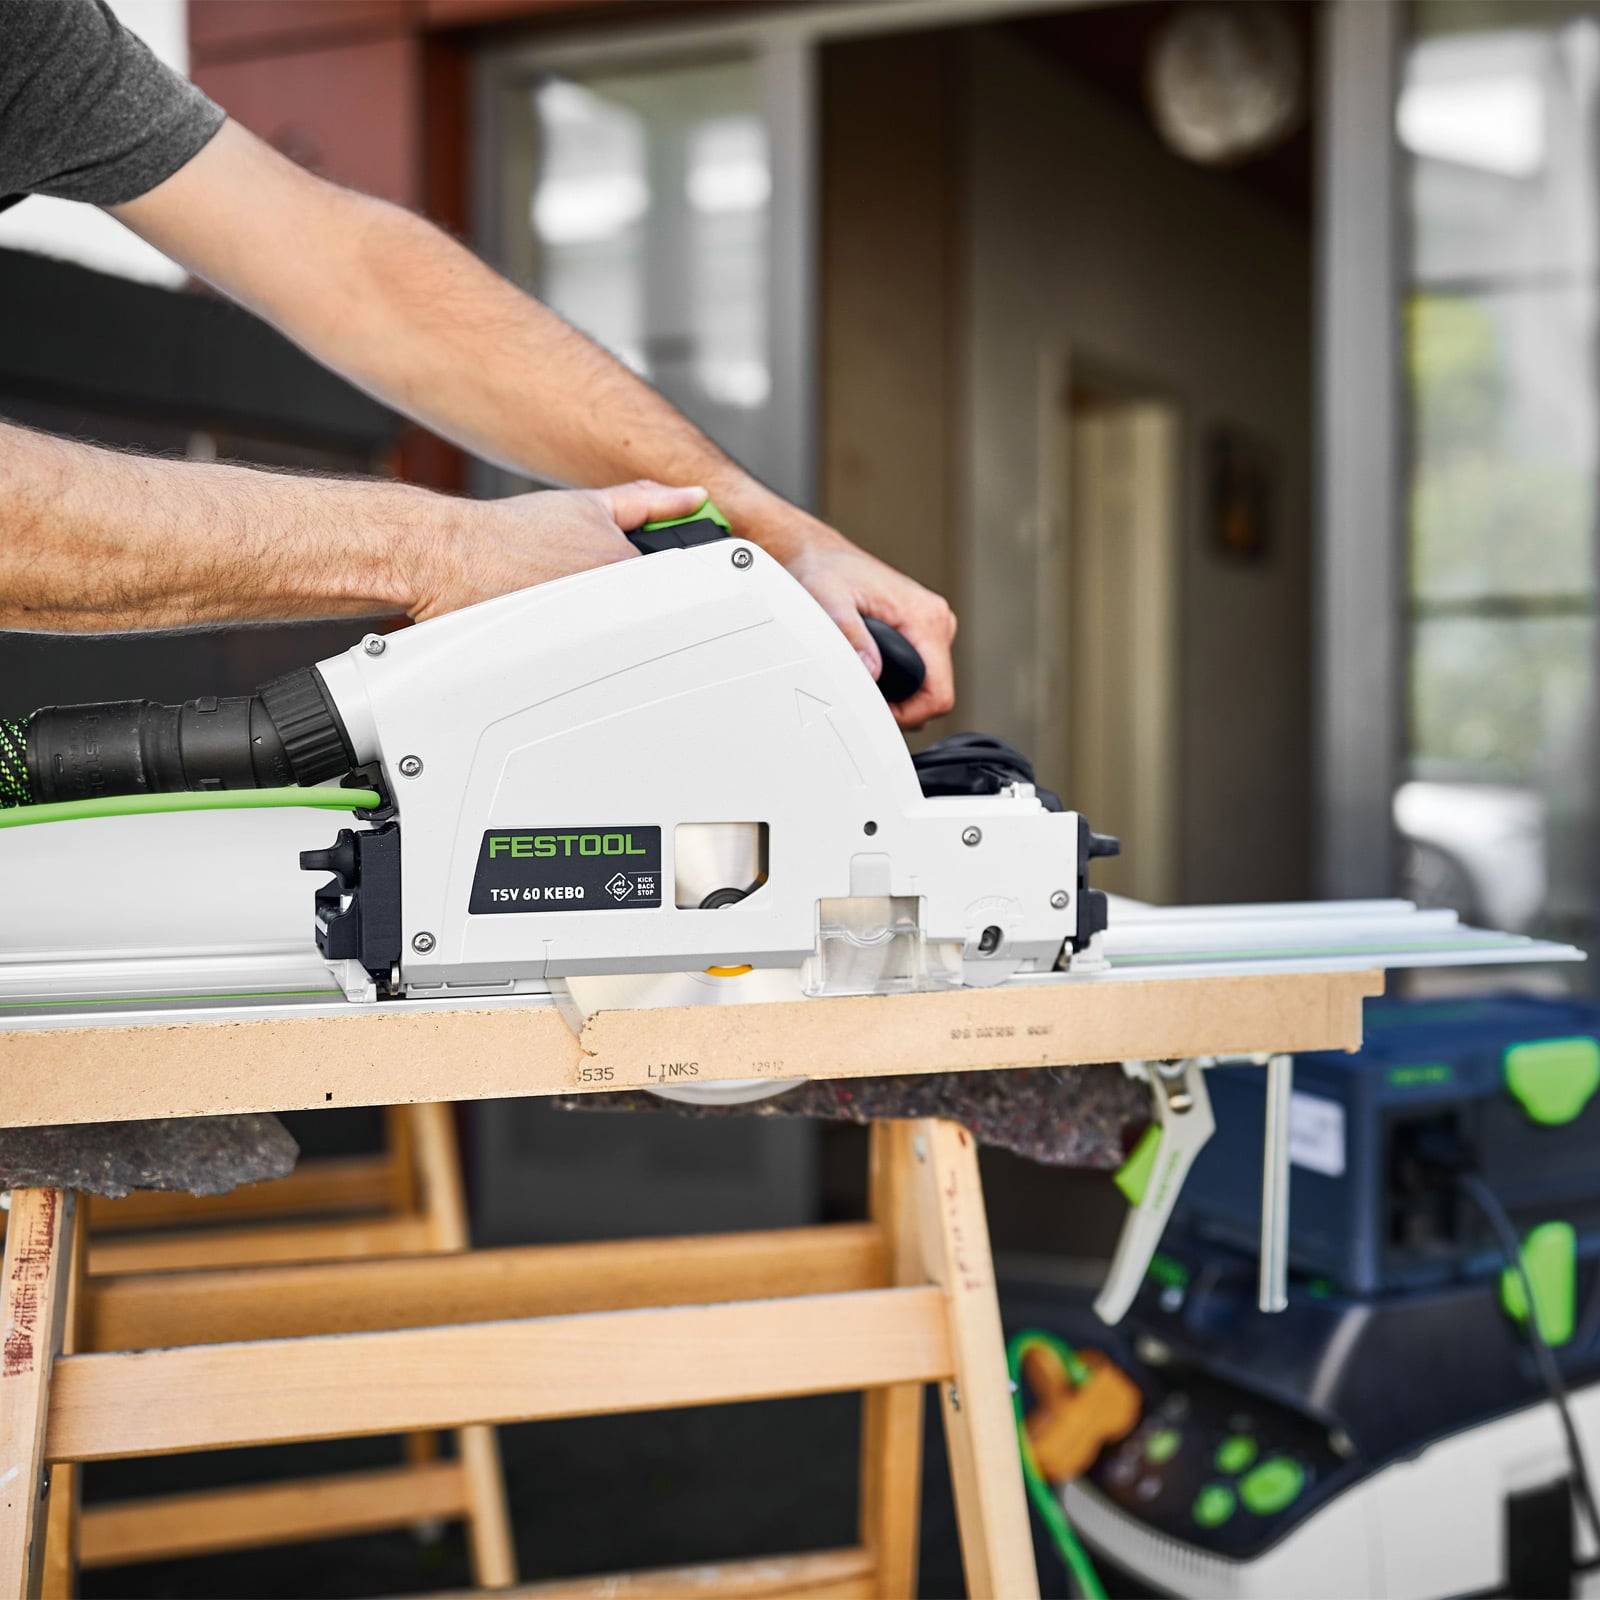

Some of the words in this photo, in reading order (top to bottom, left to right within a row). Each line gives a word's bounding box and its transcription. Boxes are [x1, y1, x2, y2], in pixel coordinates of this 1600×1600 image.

[489, 833, 646, 858] FESTOOL
[490, 888, 520, 901] TSV
[522, 887, 540, 900] 60
[544, 886, 585, 900] KEBQ
[647, 1062, 699, 1078] LINKS
